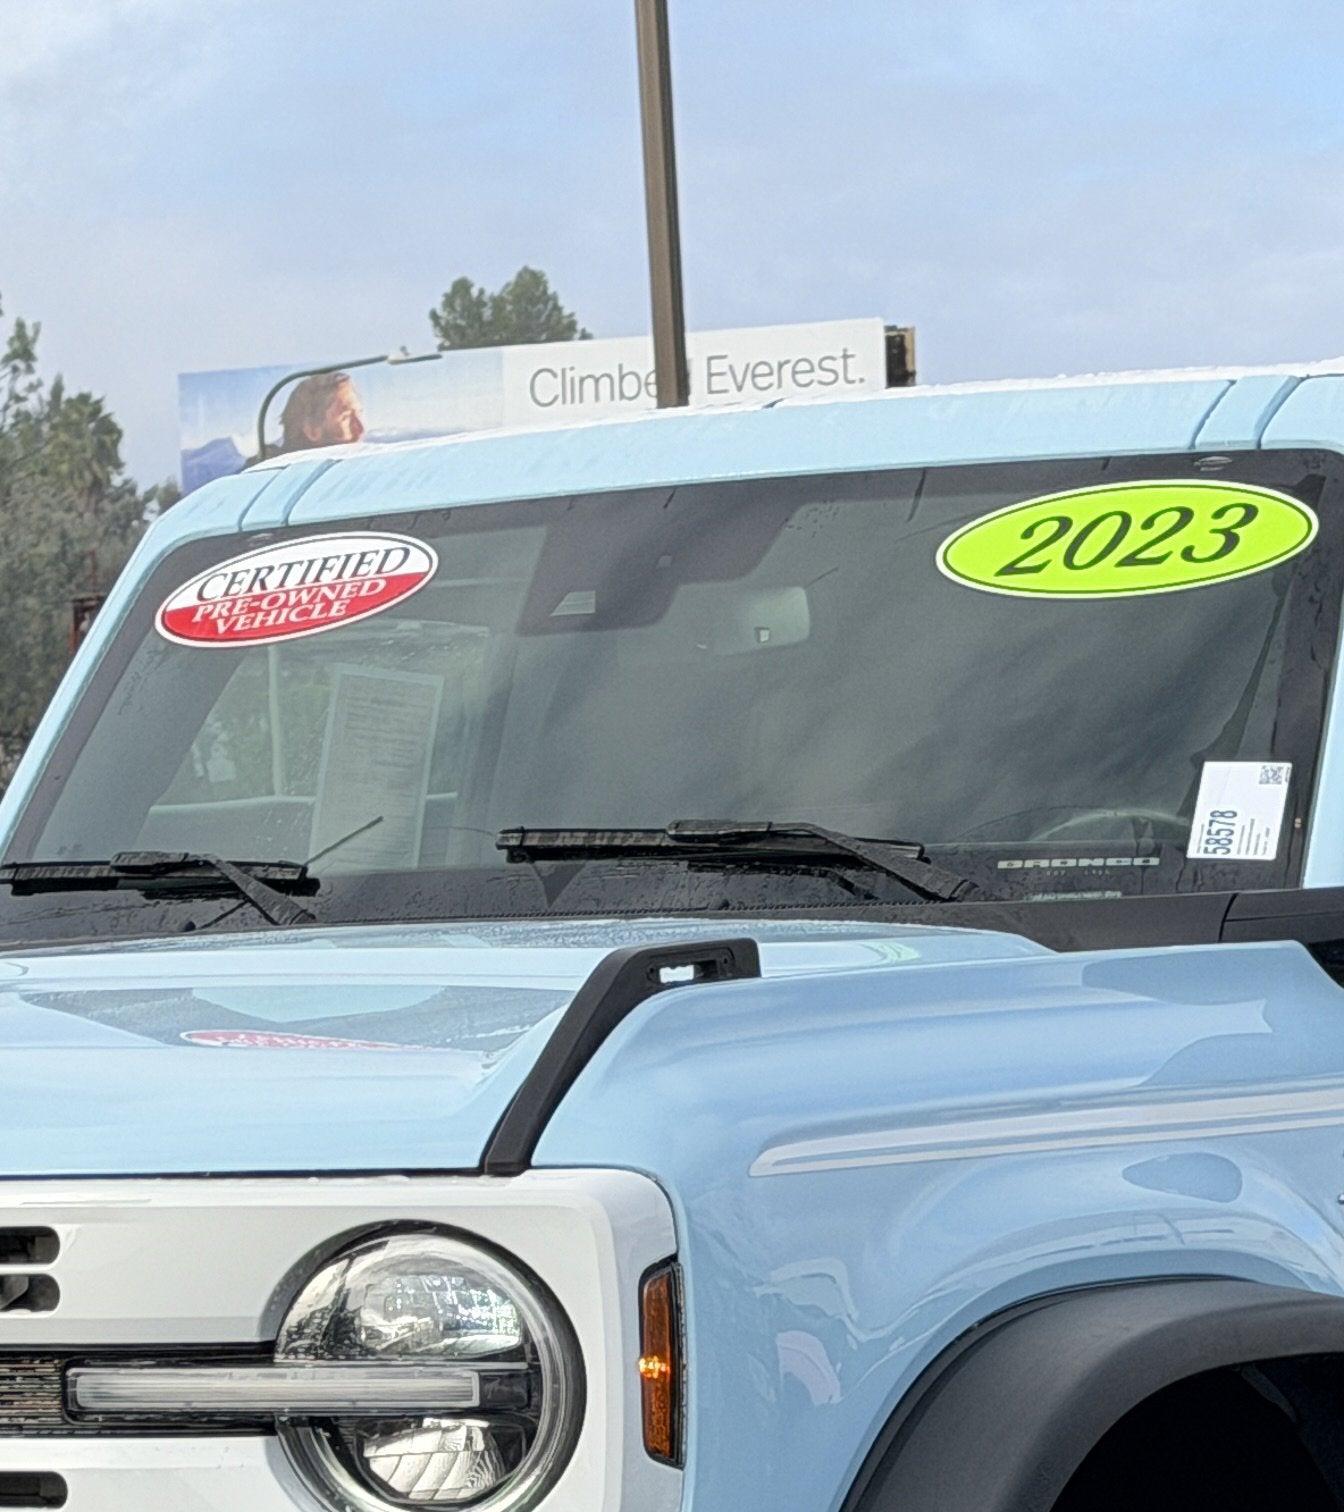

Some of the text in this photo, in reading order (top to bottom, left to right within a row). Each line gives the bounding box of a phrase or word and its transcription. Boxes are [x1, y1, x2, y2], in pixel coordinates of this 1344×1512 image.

[529, 348, 866, 408] Climbe Everest.
[994, 502, 1260, 577] 2023
[197, 546, 411, 602] CERTIFIED
[192, 578, 386, 623] PRE-OWNED
[215, 599, 351, 635] VEHICLE
[1203, 809, 1238, 855] 58578
